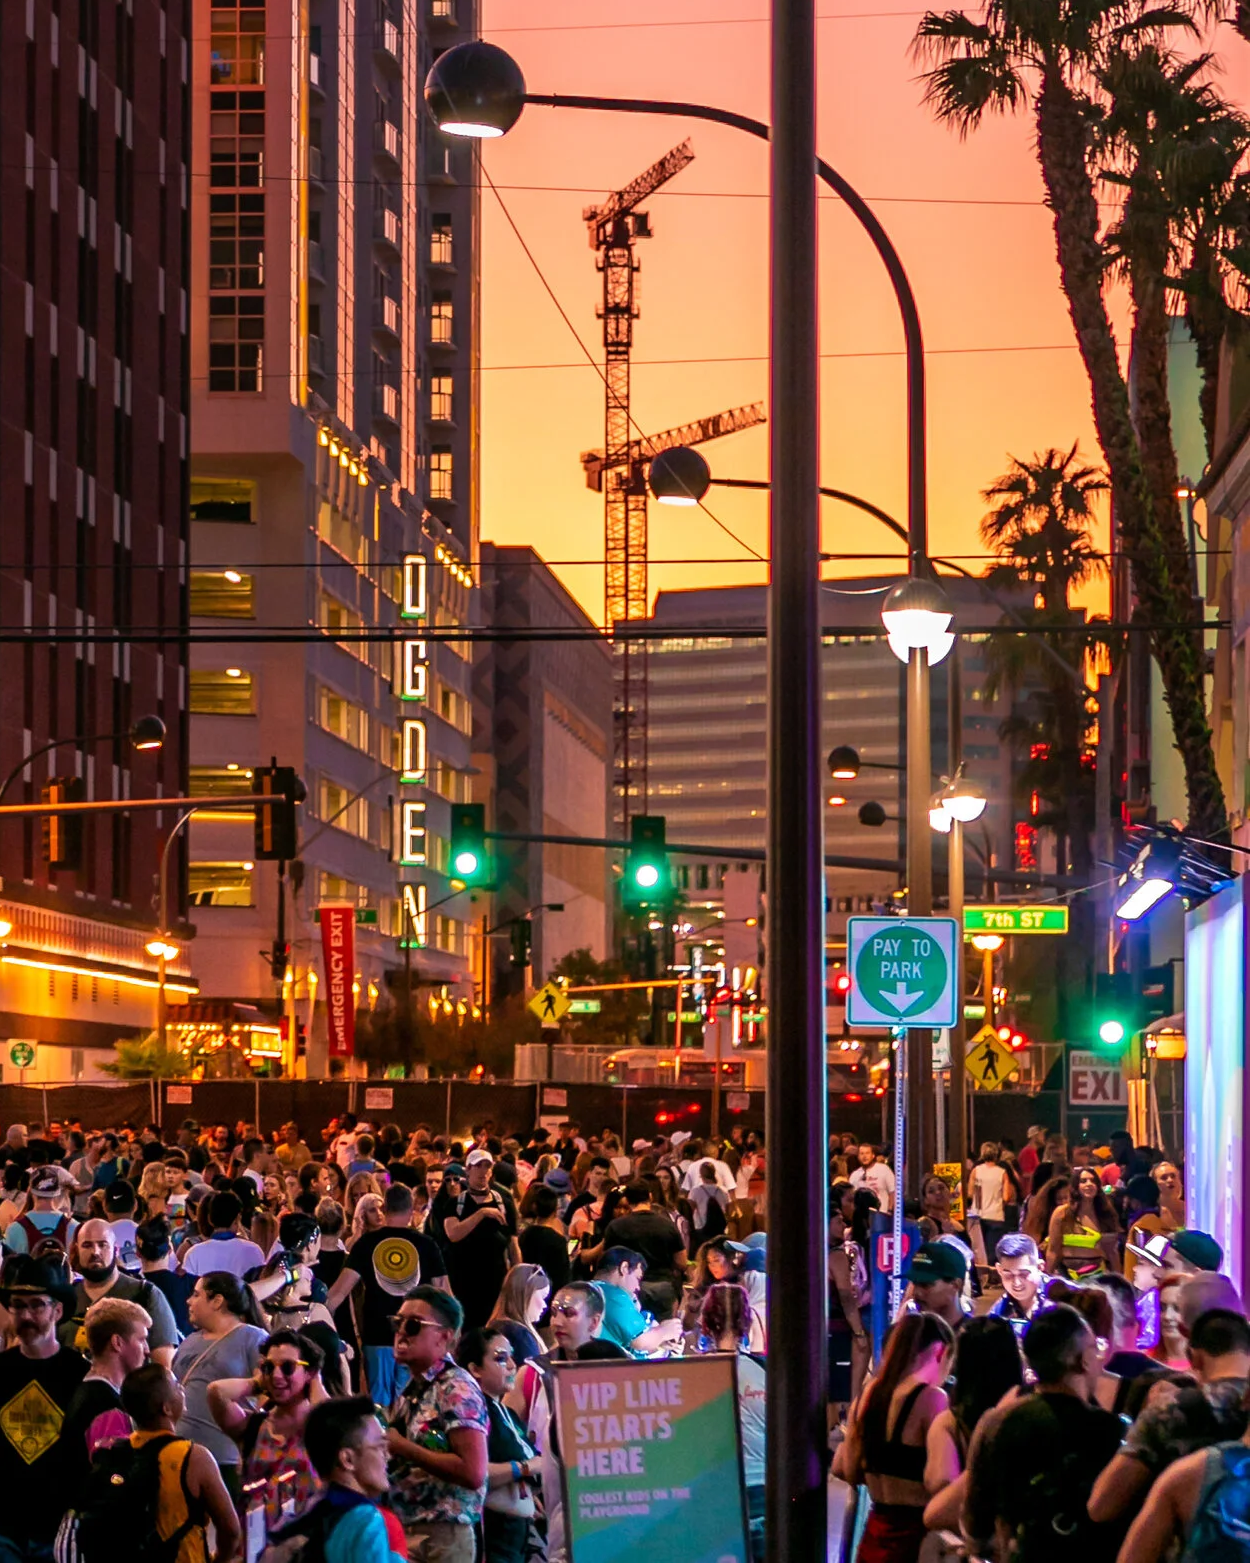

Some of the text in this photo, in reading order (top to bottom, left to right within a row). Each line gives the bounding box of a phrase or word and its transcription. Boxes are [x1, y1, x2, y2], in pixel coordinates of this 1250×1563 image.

[982, 911, 1045, 928] 7th ST
[873, 938, 931, 957] PAY TO
[330, 911, 347, 1051] EMERGENCY EXIT
[880, 961, 922, 979] PARK
[1071, 1070, 1121, 1101] EXI
[571, 1377, 683, 1411] VIP LINE
[574, 1411, 673, 1444] STARTS
[576, 1446, 645, 1477] HERE
[578, 1487, 691, 1504] COOLEST KIDS ON THE
[578, 1504, 650, 1519] PLAYGROUND
